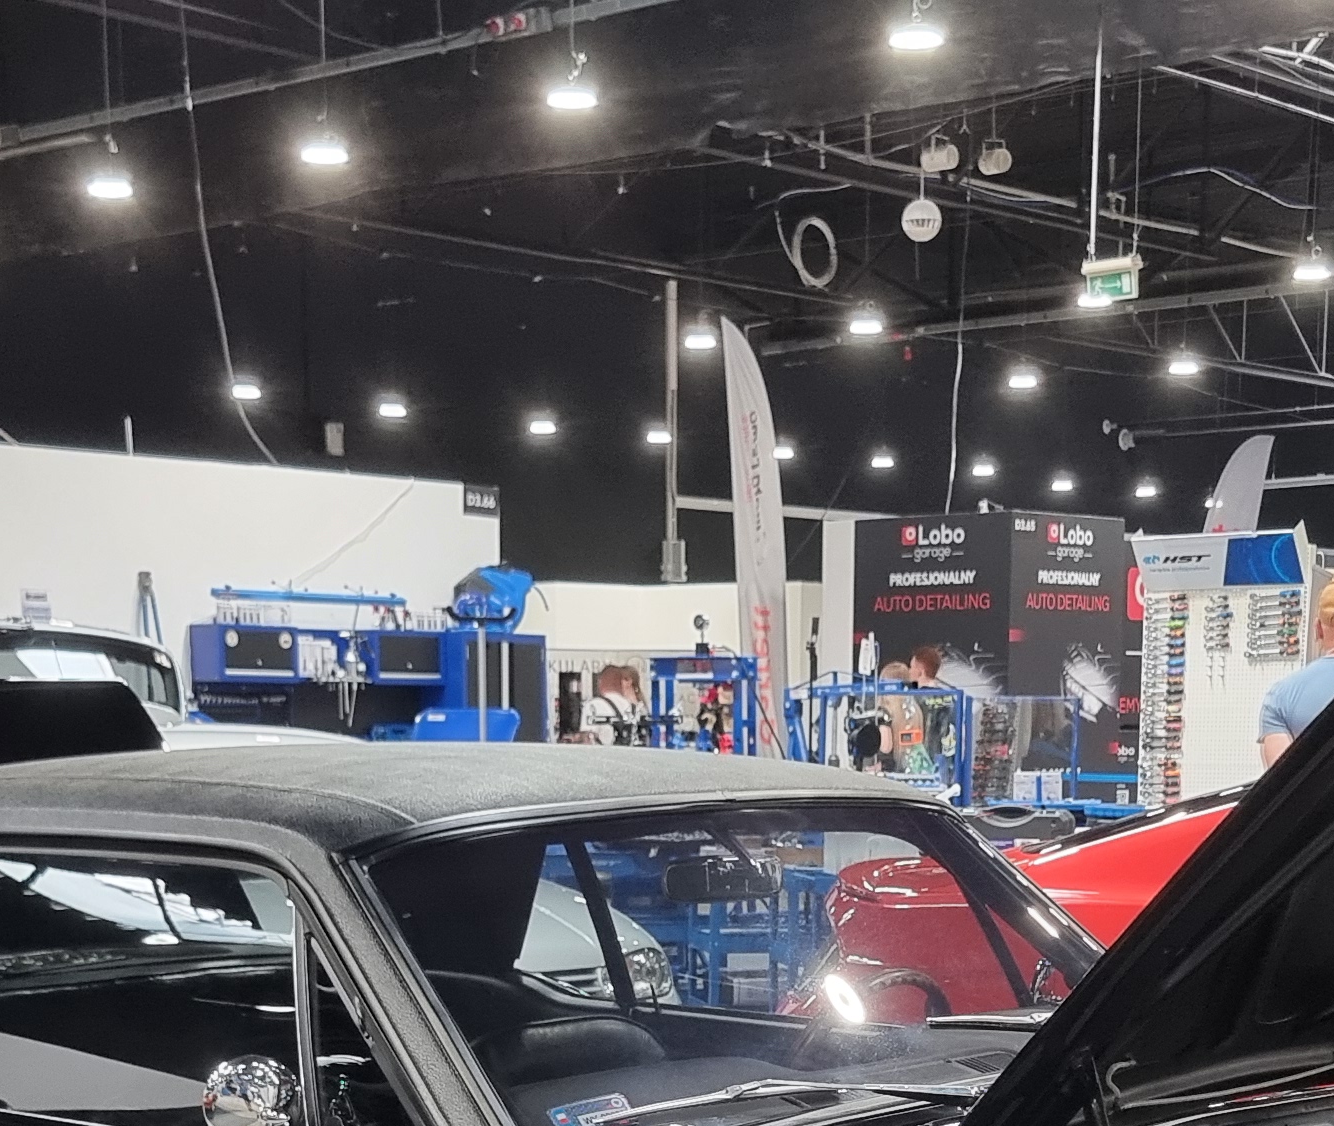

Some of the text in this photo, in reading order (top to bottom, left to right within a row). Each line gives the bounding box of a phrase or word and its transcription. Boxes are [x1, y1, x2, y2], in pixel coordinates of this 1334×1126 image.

[917, 523, 965, 546] Lobo
[1059, 524, 1094, 546] Lobo
[913, 547, 952, 562] garage
[1056, 546, 1084, 562] garage
[1162, 554, 1211, 564] HST
[889, 570, 976, 587] PROFESJONALNY
[1037, 569, 1101, 586] PROFESJONALNY
[874, 592, 991, 612] AUTO DETAILING
[1025, 592, 1110, 612] AUTO DETAILING
[549, 659, 607, 674] KULAR
